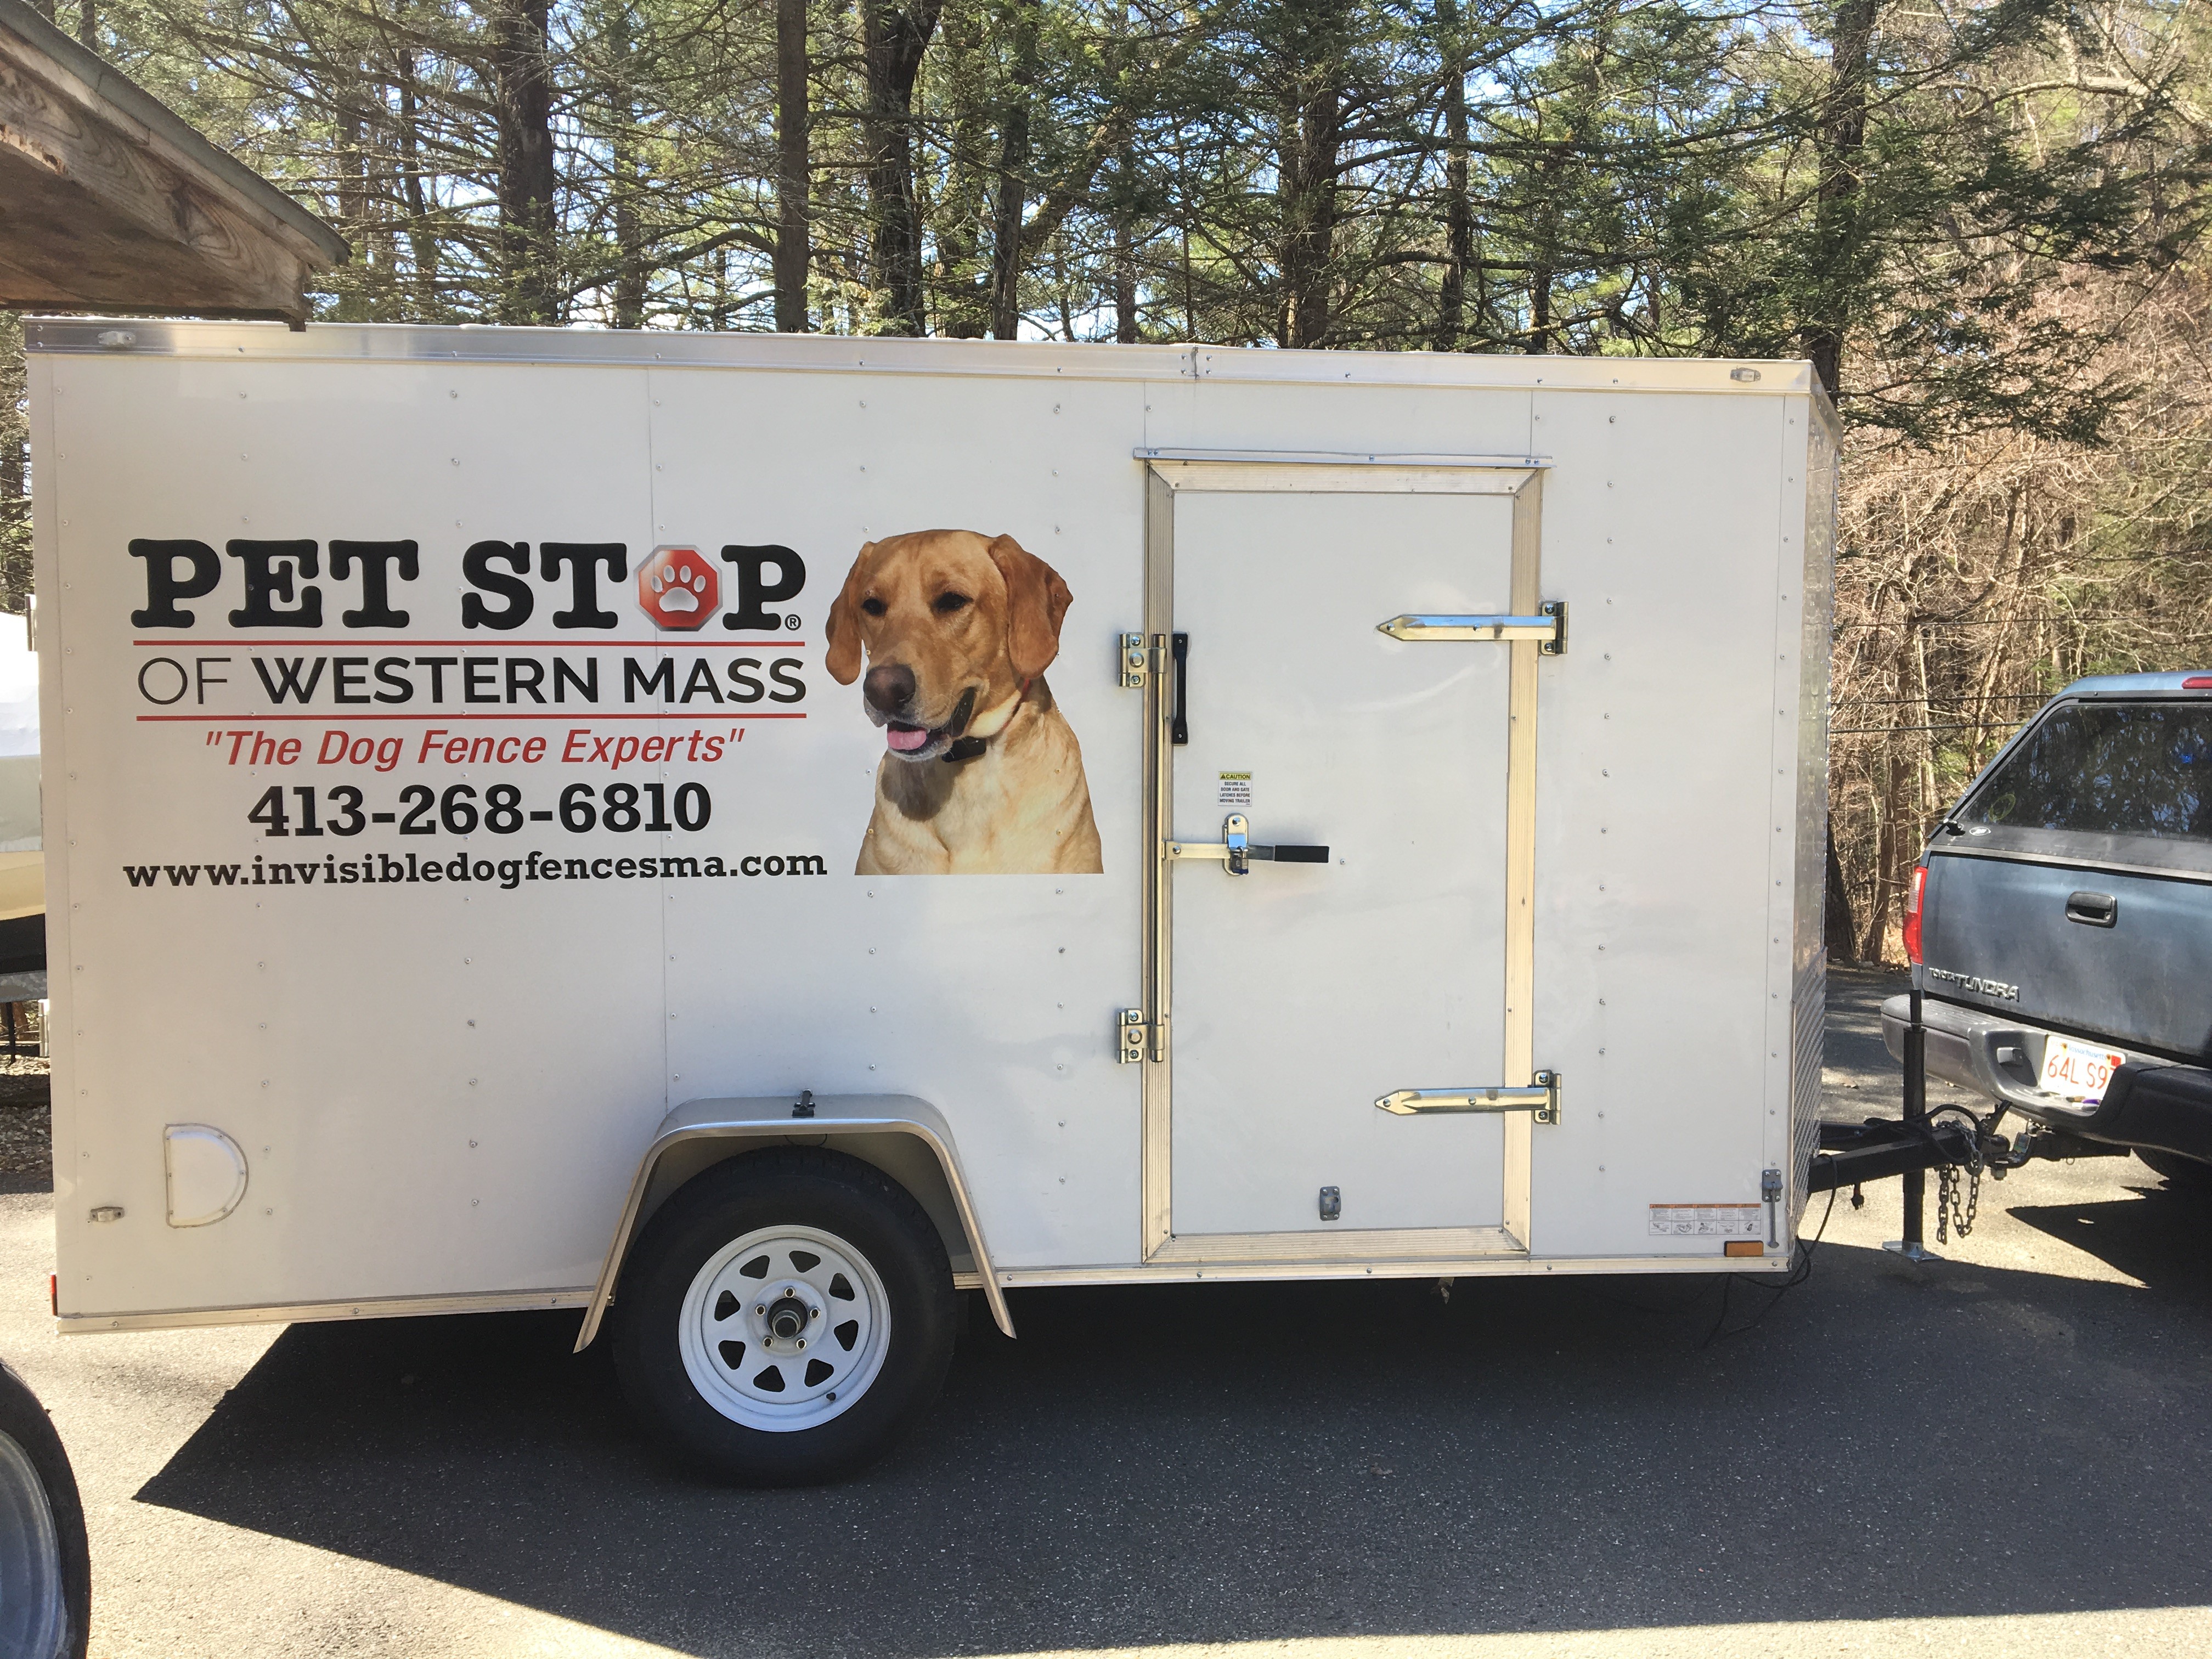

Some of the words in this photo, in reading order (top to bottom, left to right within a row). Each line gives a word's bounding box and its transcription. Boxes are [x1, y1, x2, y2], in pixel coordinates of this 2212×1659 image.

[128, 538, 419, 628] PET
[138, 657, 231, 704] OF
[251, 656, 597, 704] WESTERN
[623, 657, 806, 703] MASS
[205, 730, 302, 765] "The
[317, 730, 403, 772] Dog
[417, 729, 546, 764] Fence
[561, 728, 745, 770] Experts"
[247, 782, 712, 837] 413-268-6810
[123, 850, 827, 889] www.invisibledogfencesma.com
[1955, 973, 2019, 1002] TUNDRA
[2047, 1054, 2079, 1085] 64L
